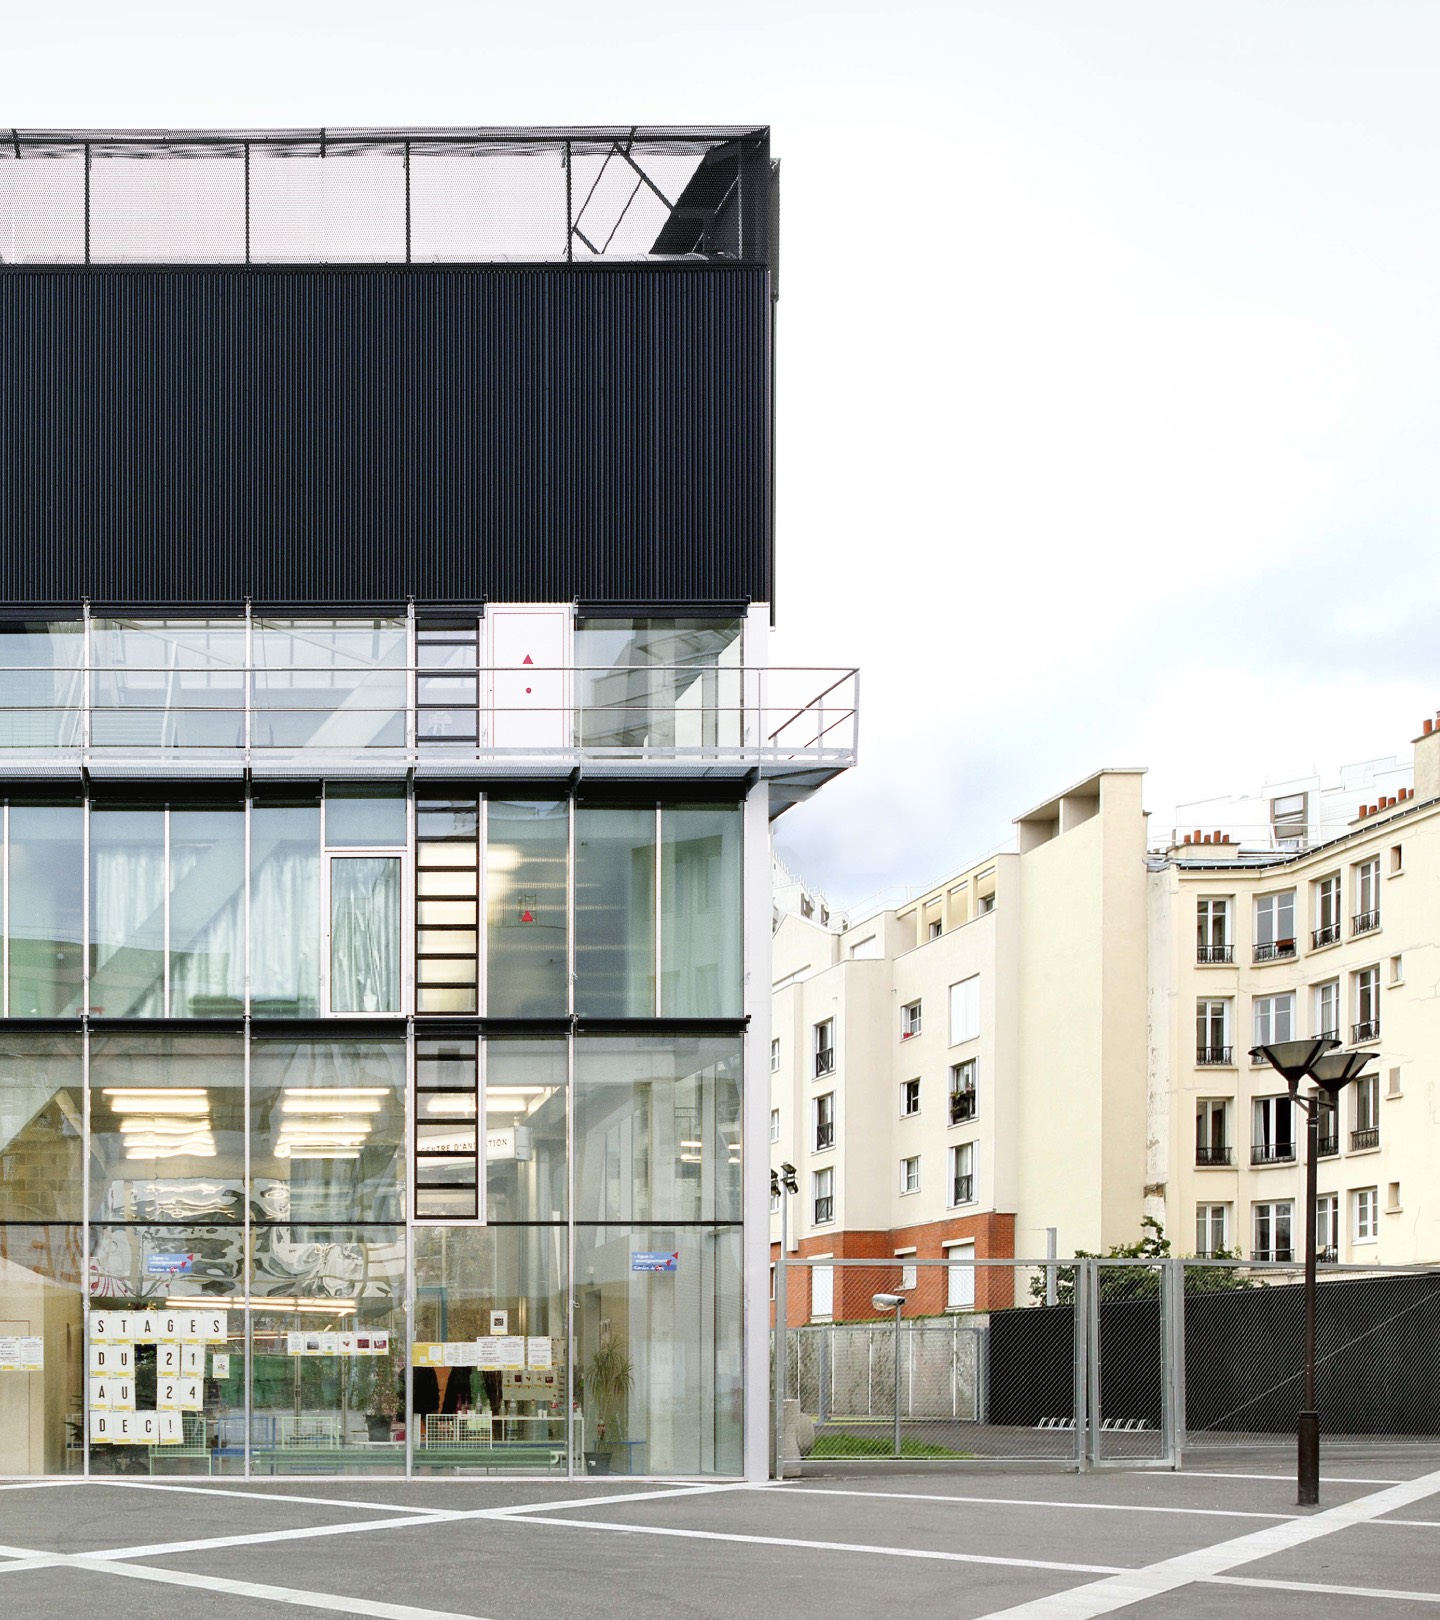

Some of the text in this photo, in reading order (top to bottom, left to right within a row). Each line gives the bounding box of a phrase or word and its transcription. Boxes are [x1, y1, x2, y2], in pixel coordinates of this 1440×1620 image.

[454, 1138, 508, 1151] D'ANITION
[97, 1319, 220, 1333] STAGES
[98, 1351, 195, 1366] DU 21
[98, 1385, 196, 1400] AU 24
[99, 1418, 173, 1433] DEC!
